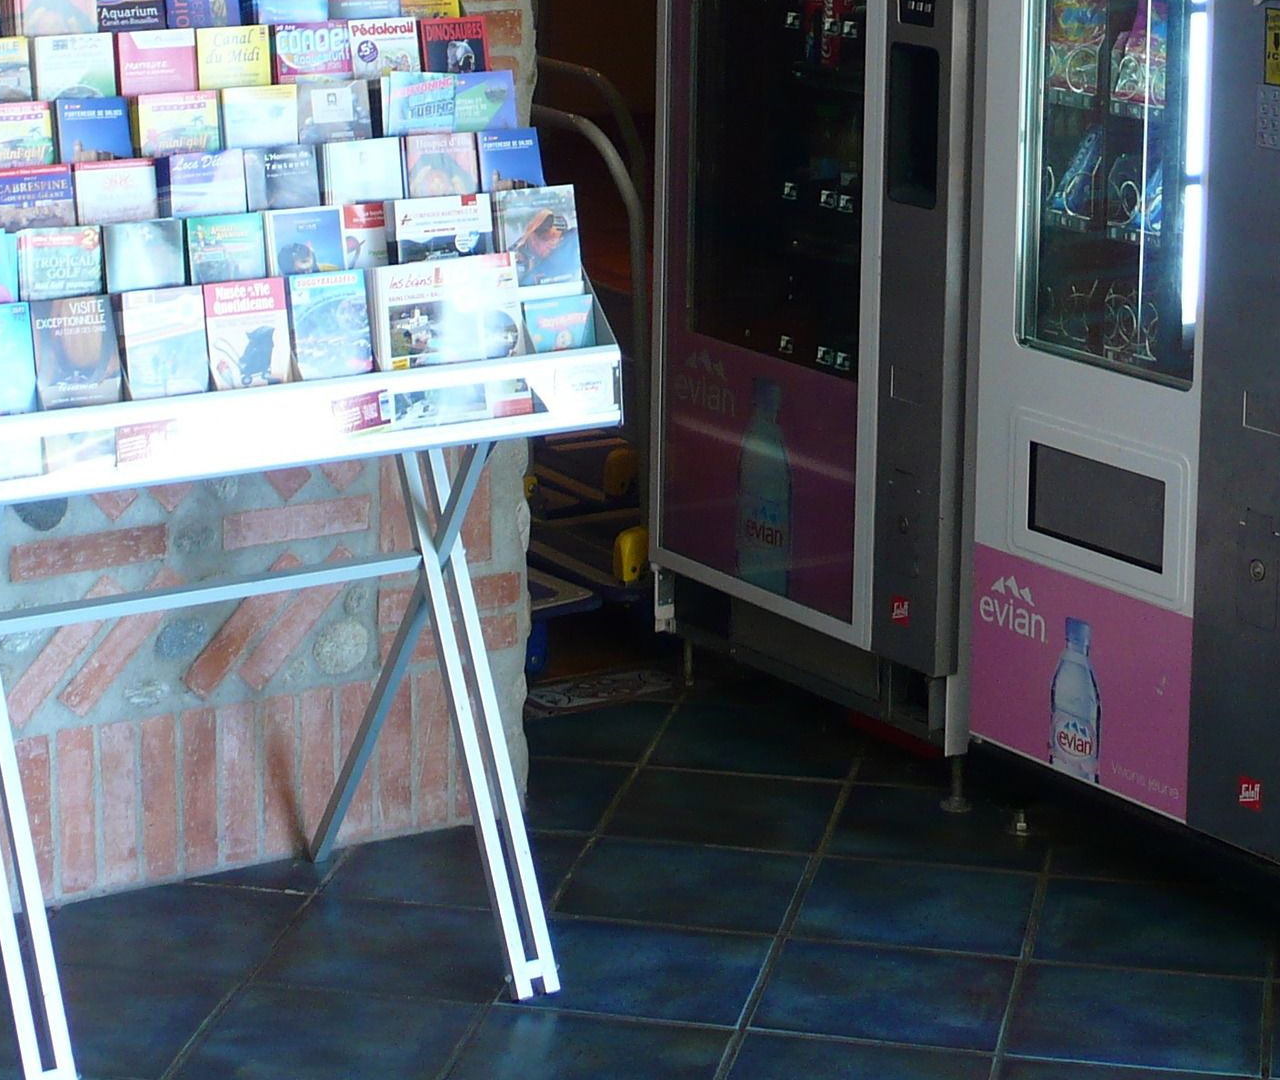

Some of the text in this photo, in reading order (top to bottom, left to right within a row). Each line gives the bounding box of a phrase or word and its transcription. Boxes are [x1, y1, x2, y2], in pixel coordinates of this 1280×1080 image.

[425, 22, 483, 41] DINOSAURES
[228, 47, 261, 64] Midi
[46, 268, 81, 280] GOLF
[68, 299, 106, 314] VISITE
[35, 313, 106, 330] EXCEPTIONNELLE
[675, 373, 736, 417] evian
[745, 518, 785, 549] evian
[978, 591, 1048, 645] evian
[1056, 729, 1094, 755] evian
